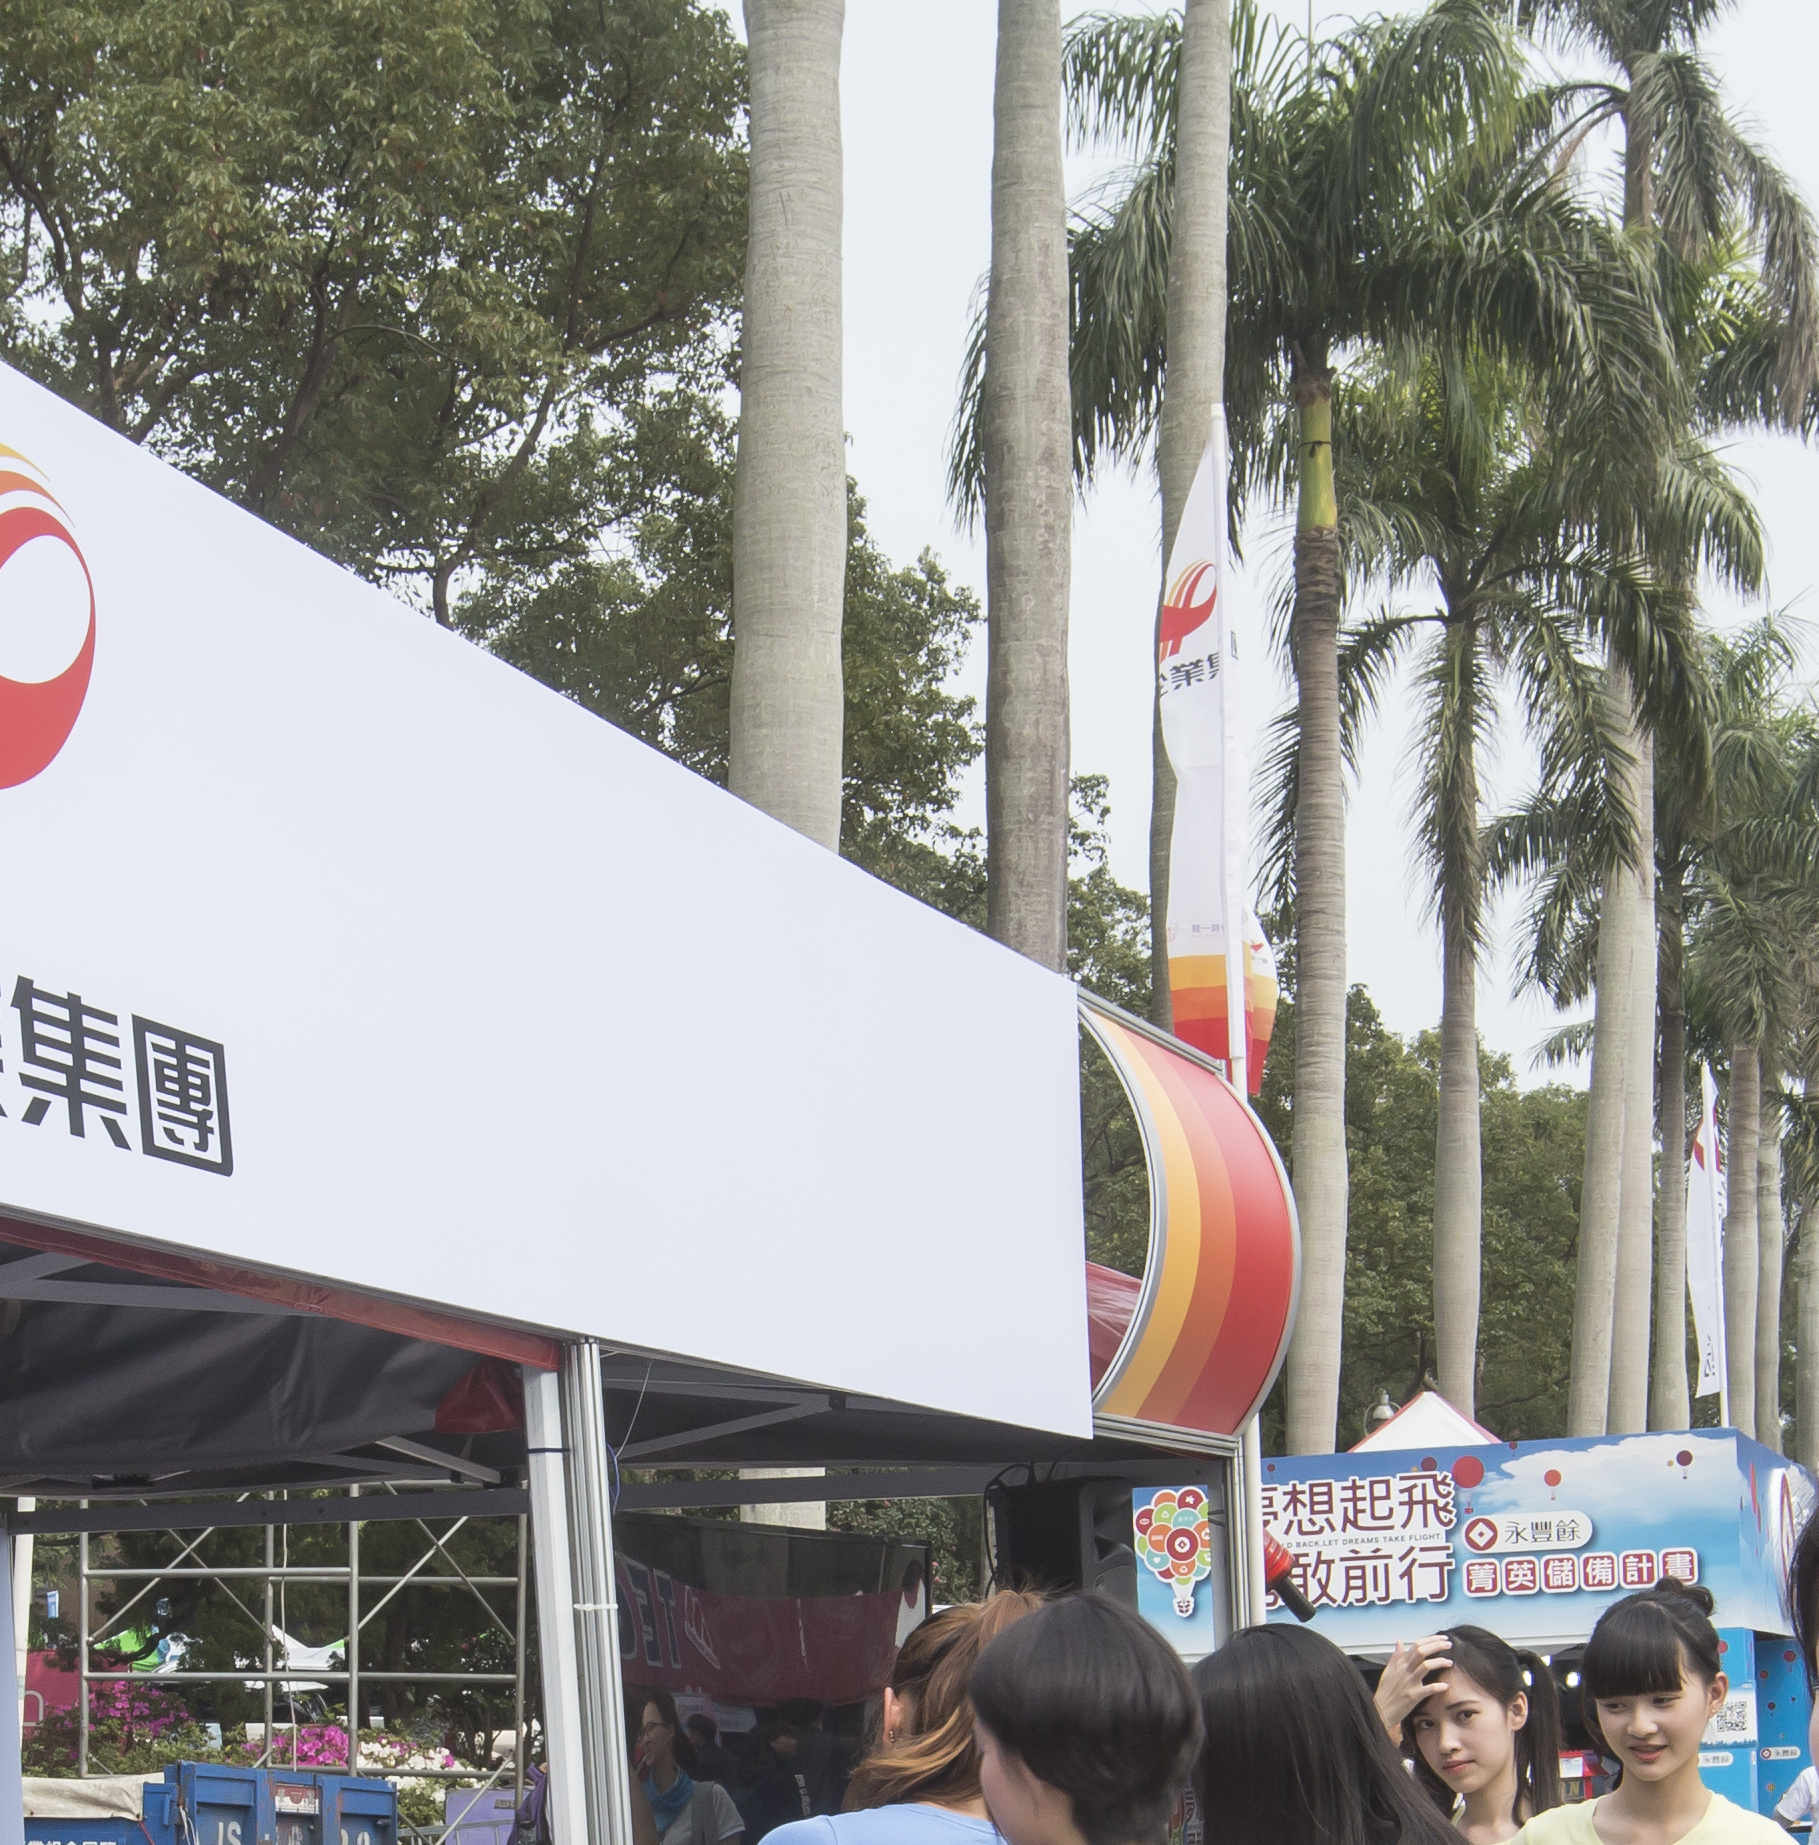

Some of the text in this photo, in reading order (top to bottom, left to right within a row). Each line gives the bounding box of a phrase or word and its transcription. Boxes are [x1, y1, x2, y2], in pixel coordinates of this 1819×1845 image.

[1503, 1517, 1582, 1547] 永豐餘
[1265, 1544, 1456, 1609] 敢前行
[1466, 1551, 1695, 1594] 菁英儲備計畫
